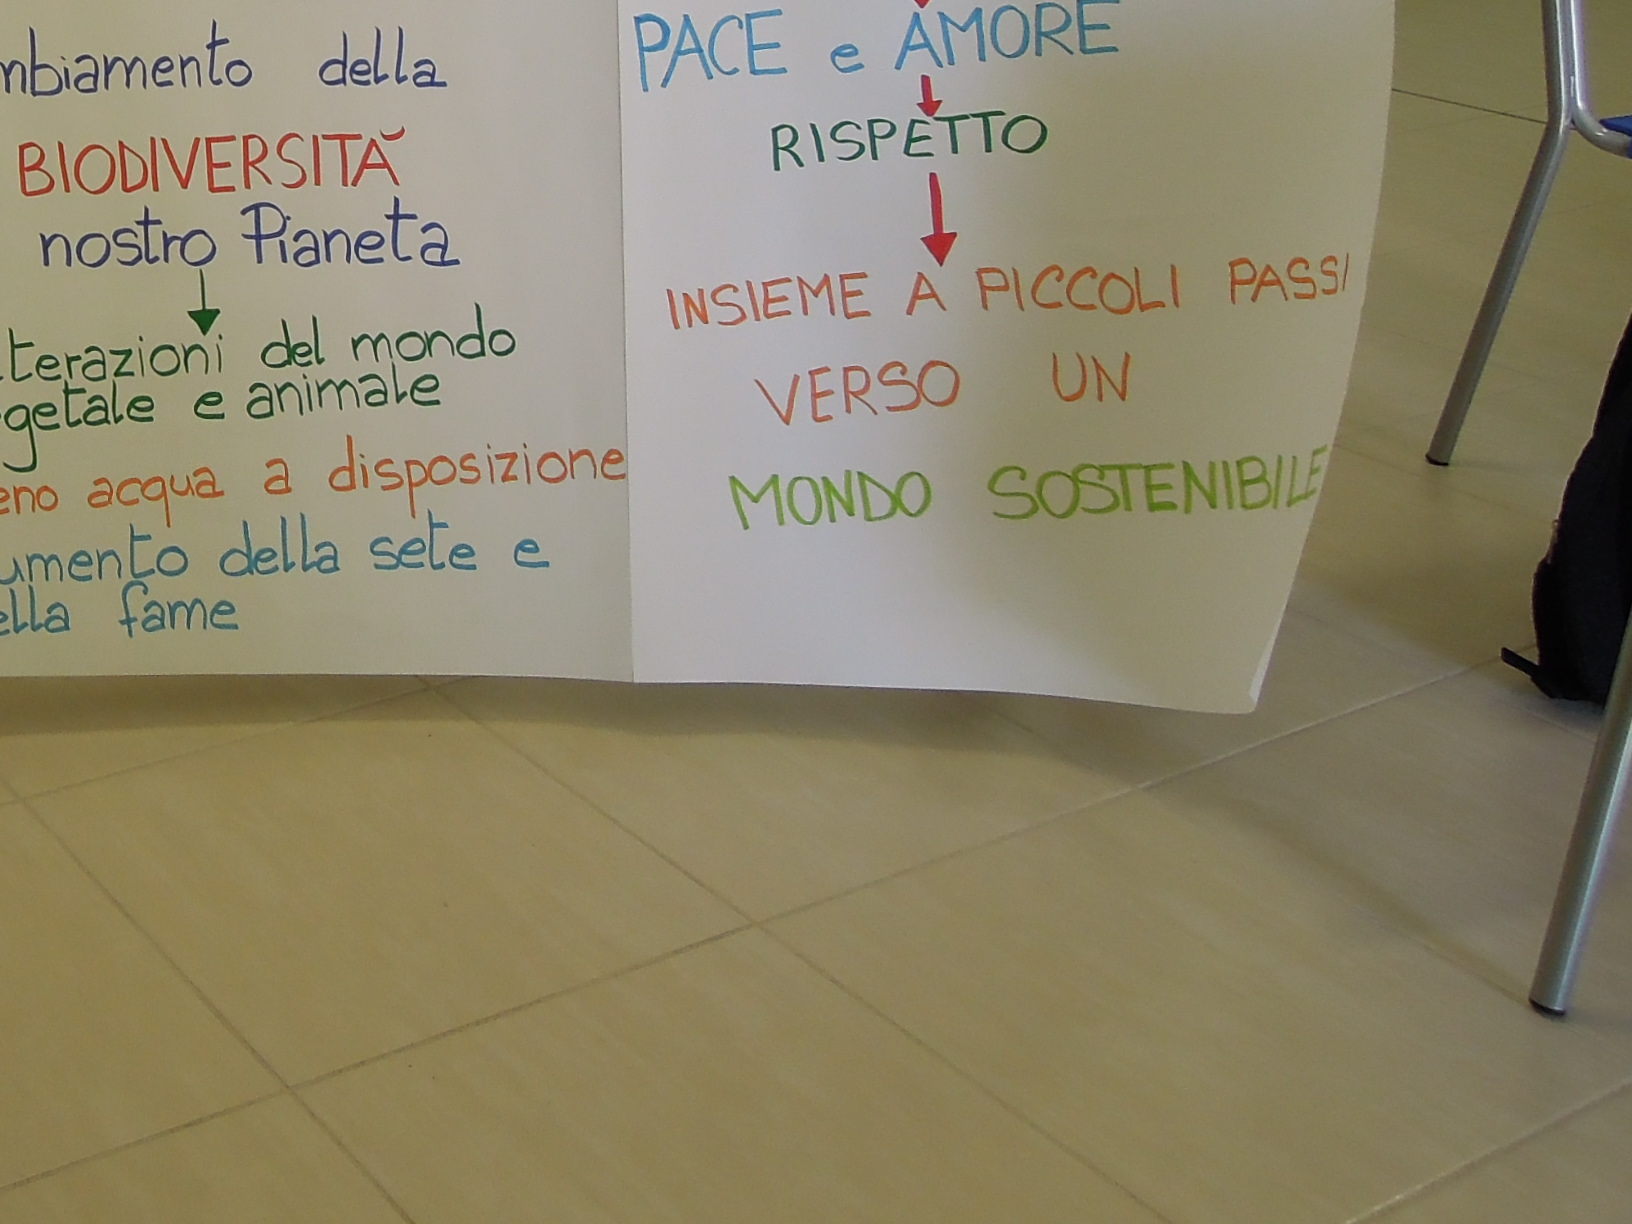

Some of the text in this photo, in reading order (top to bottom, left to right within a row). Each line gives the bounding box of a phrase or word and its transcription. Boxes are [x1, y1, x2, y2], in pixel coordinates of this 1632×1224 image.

[318, 26, 447, 89] della
[633, 8, 788, 92] PACE
[829, 41, 864, 76] e
[770, 111, 1049, 172] RISPETTO
[42, 206, 217, 269] nostro
[242, 196, 461, 268] Pianeta
[666, 254, 1351, 331] INSIEME A PICCOLI PASSI
[260, 316, 325, 370] del
[351, 304, 517, 362] mondo
[193, 389, 226, 421] e
[246, 363, 441, 419] animale
[754, 351, 1132, 427] VERSO UN
[86, 469, 226, 528] acqua
[263, 460, 293, 496] a
[328, 435, 626, 519] disposizione
[726, 443, 1330, 531] MONDO SOSTENIBILE
[219, 514, 340, 578] della
[369, 510, 478, 573] sete
[512, 533, 550, 570] e
[119, 582, 240, 638] fame
